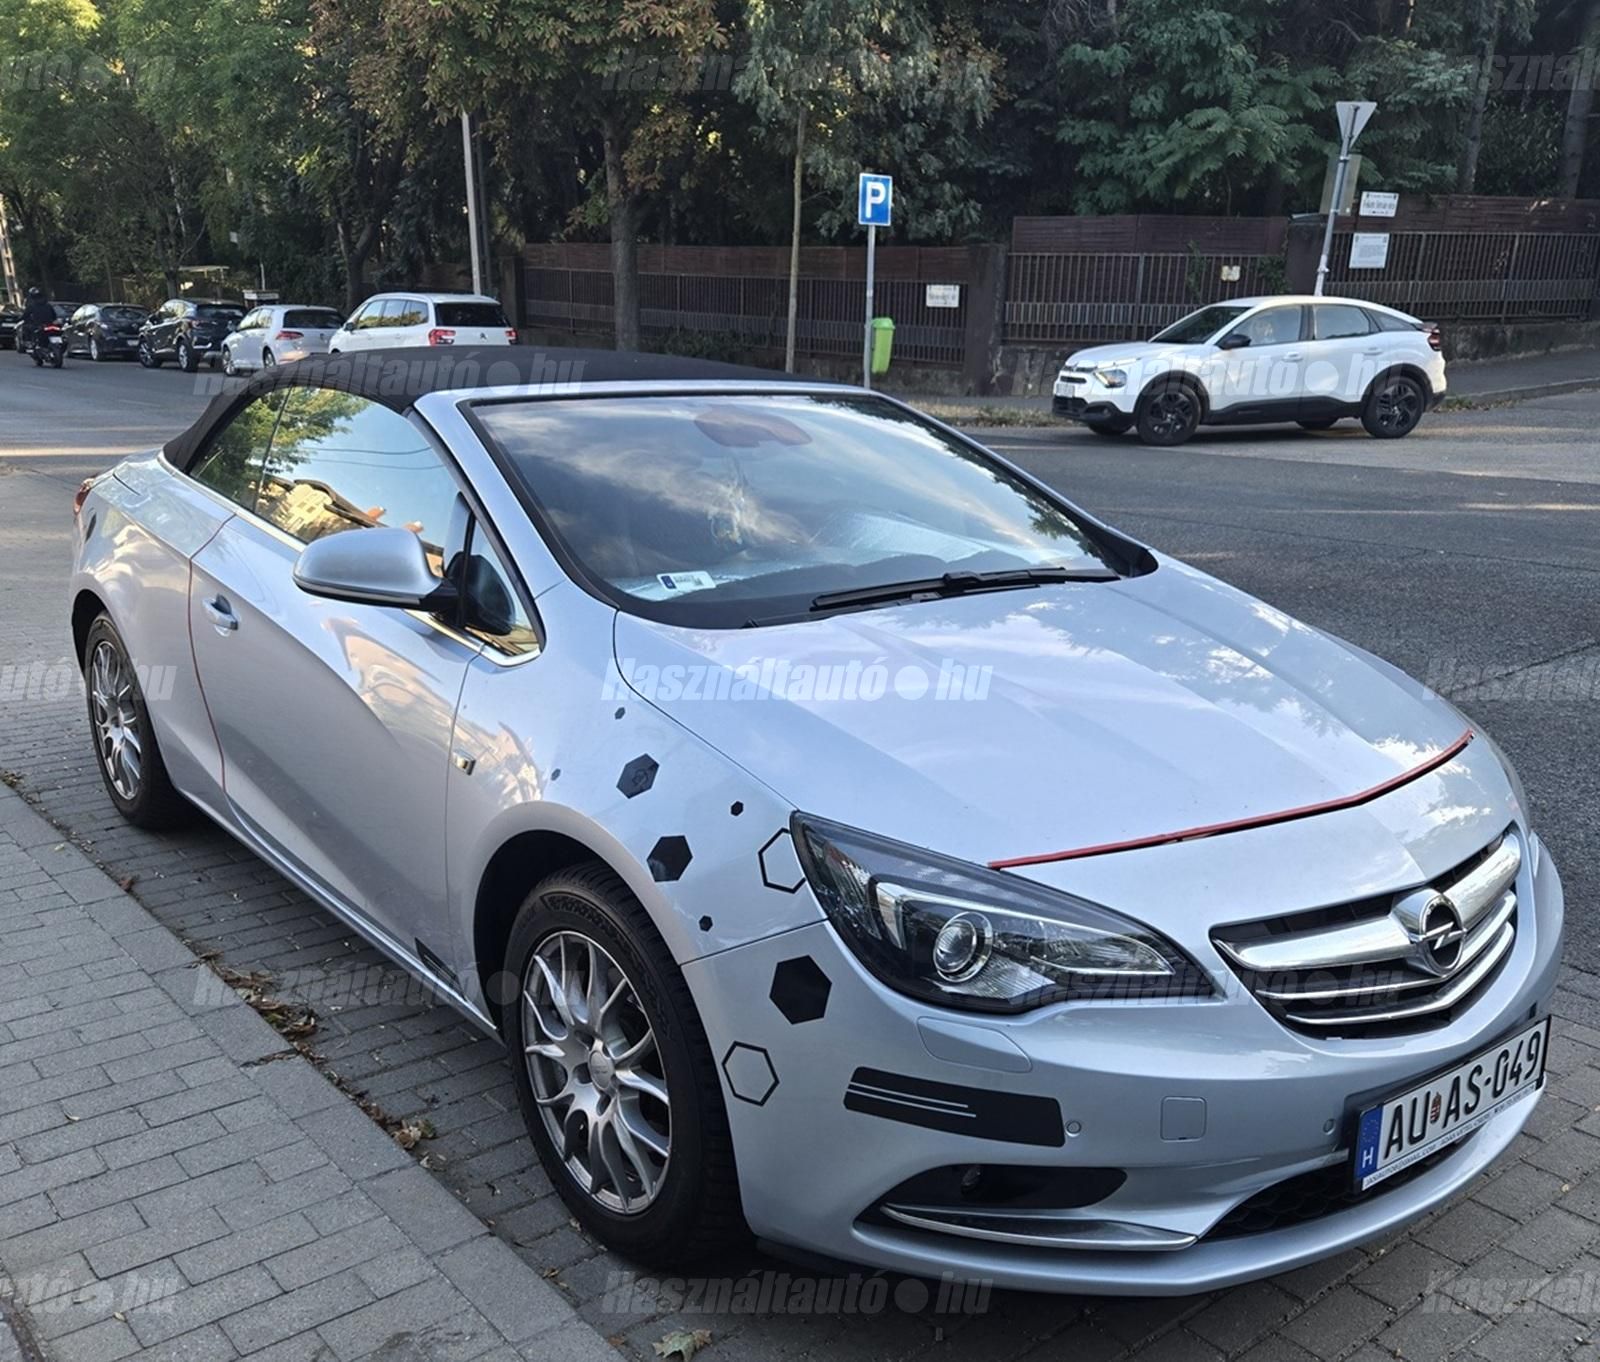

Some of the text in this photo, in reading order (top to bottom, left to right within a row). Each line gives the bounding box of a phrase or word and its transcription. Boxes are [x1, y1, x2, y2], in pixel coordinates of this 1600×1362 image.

[865, 181, 887, 218] P
[1383, 1091, 1431, 1159] AU
[1442, 1031, 1542, 1129] AS-049
[1362, 1147, 1374, 1168] H
